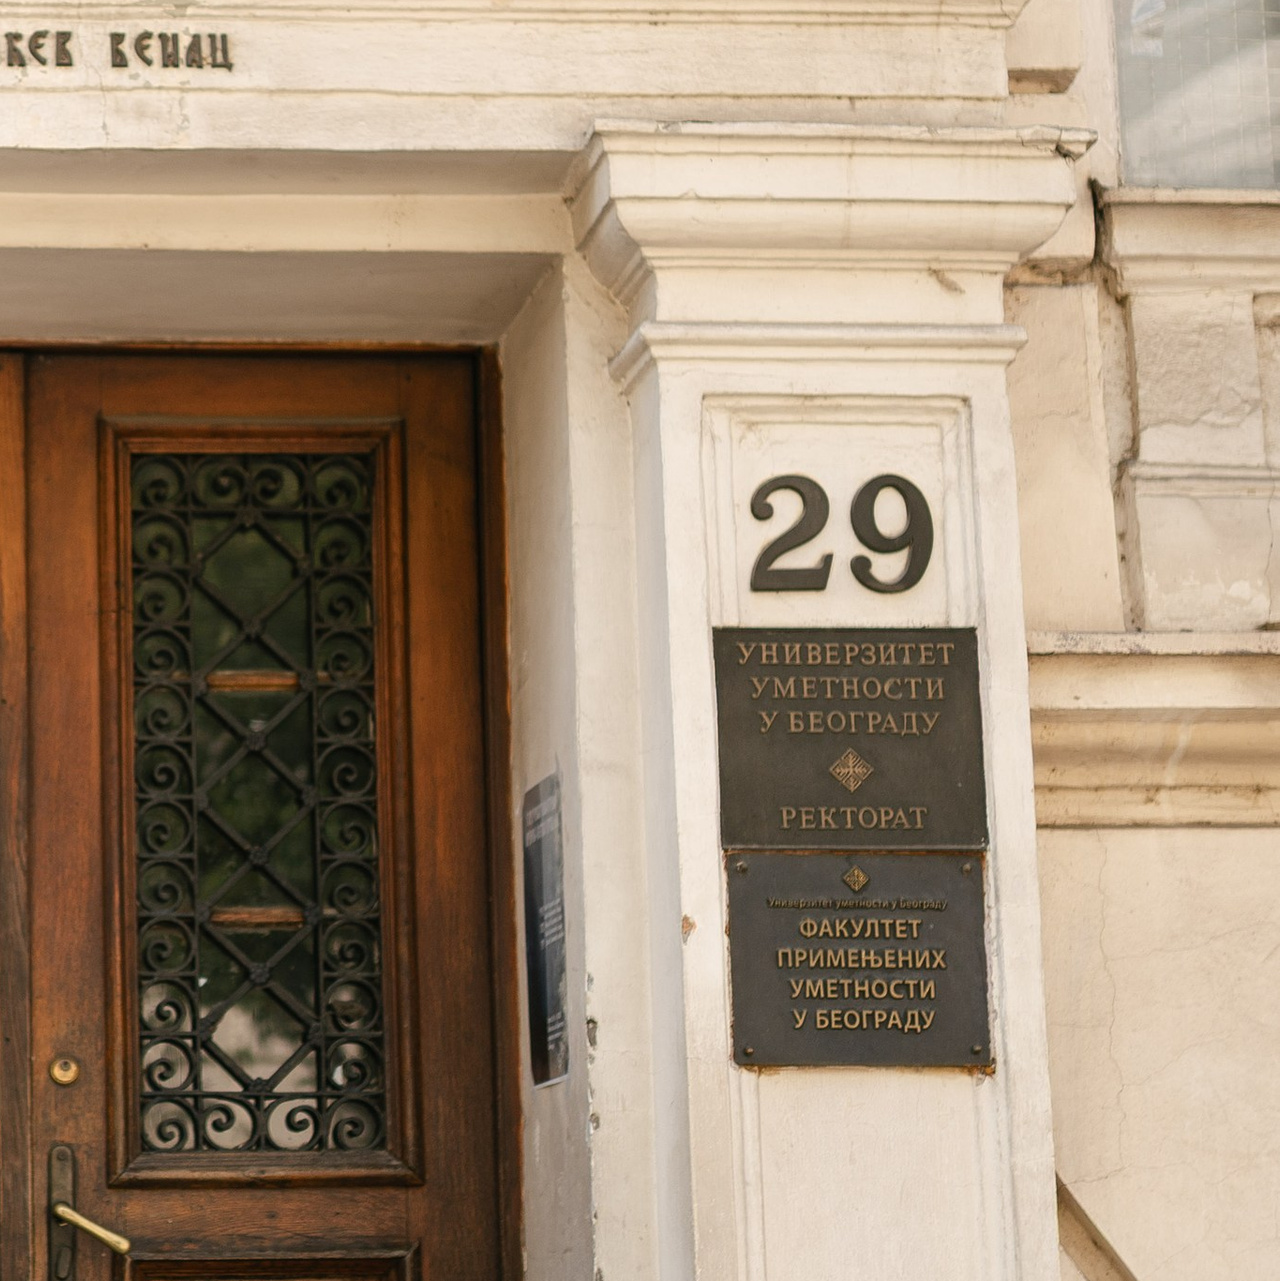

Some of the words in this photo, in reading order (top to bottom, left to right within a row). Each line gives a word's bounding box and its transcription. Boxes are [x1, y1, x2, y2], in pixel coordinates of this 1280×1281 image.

[109, 30, 234, 72] ВЕНАЦ
[750, 473, 935, 594] 29
[737, 641, 956, 666] УНИВЕРЗИТЕТ
[751, 676, 945, 701] УМЕТНОСТИ
[759, 710, 780, 735] У
[789, 710, 942, 737] БЕОГРАДУ
[780, 806, 928, 830] РЕКТОРАТ
[835, 899, 890, 911] уметности
[799, 916, 922, 939] ФАКУЛТЕТ
[777, 948, 948, 969] ПРИМЕЊЕНИХ
[790, 977, 937, 1000] УМЕТНОСТИ
[793, 1008, 808, 1030] У
[816, 1008, 937, 1033] БЕОГРАДУ
